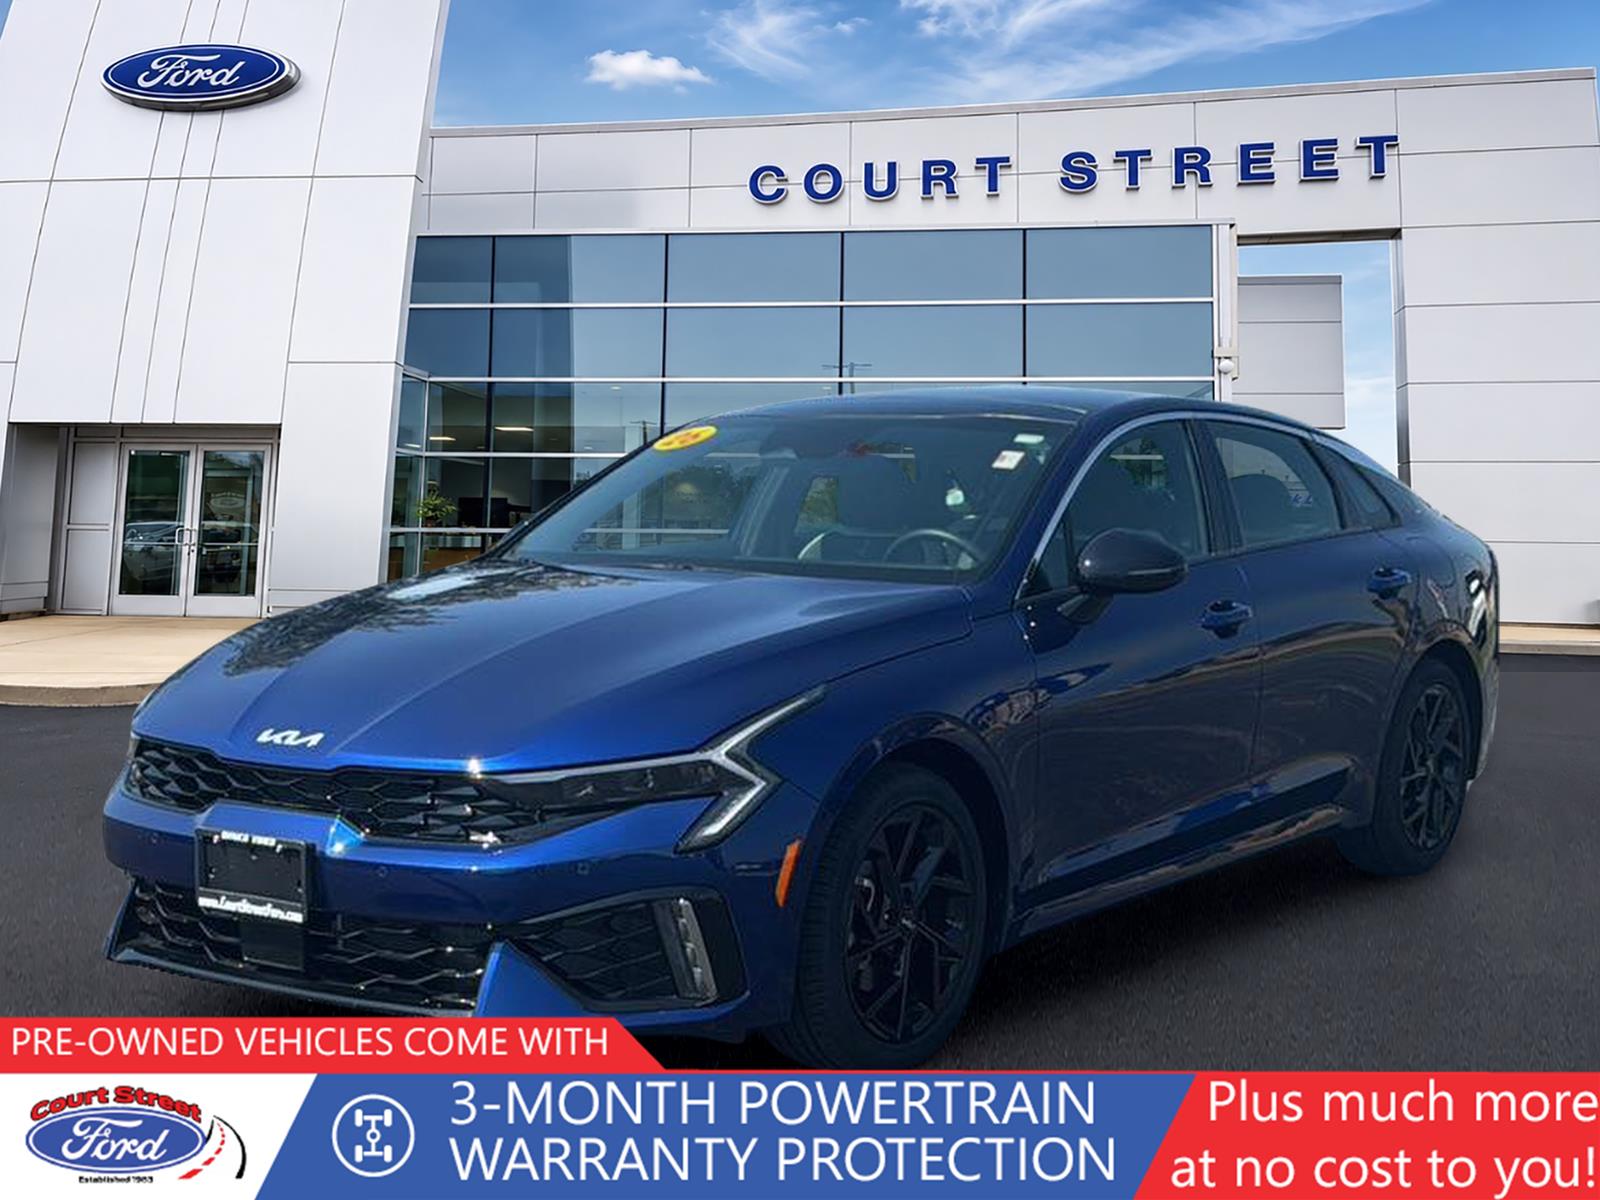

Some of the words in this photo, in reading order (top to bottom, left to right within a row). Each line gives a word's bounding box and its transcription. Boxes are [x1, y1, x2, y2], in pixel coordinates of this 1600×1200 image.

[137, 54, 246, 88] Ford
[747, 156, 1011, 204] COURT
[1059, 134, 1399, 193] STREET
[256, 728, 324, 748] KIA
